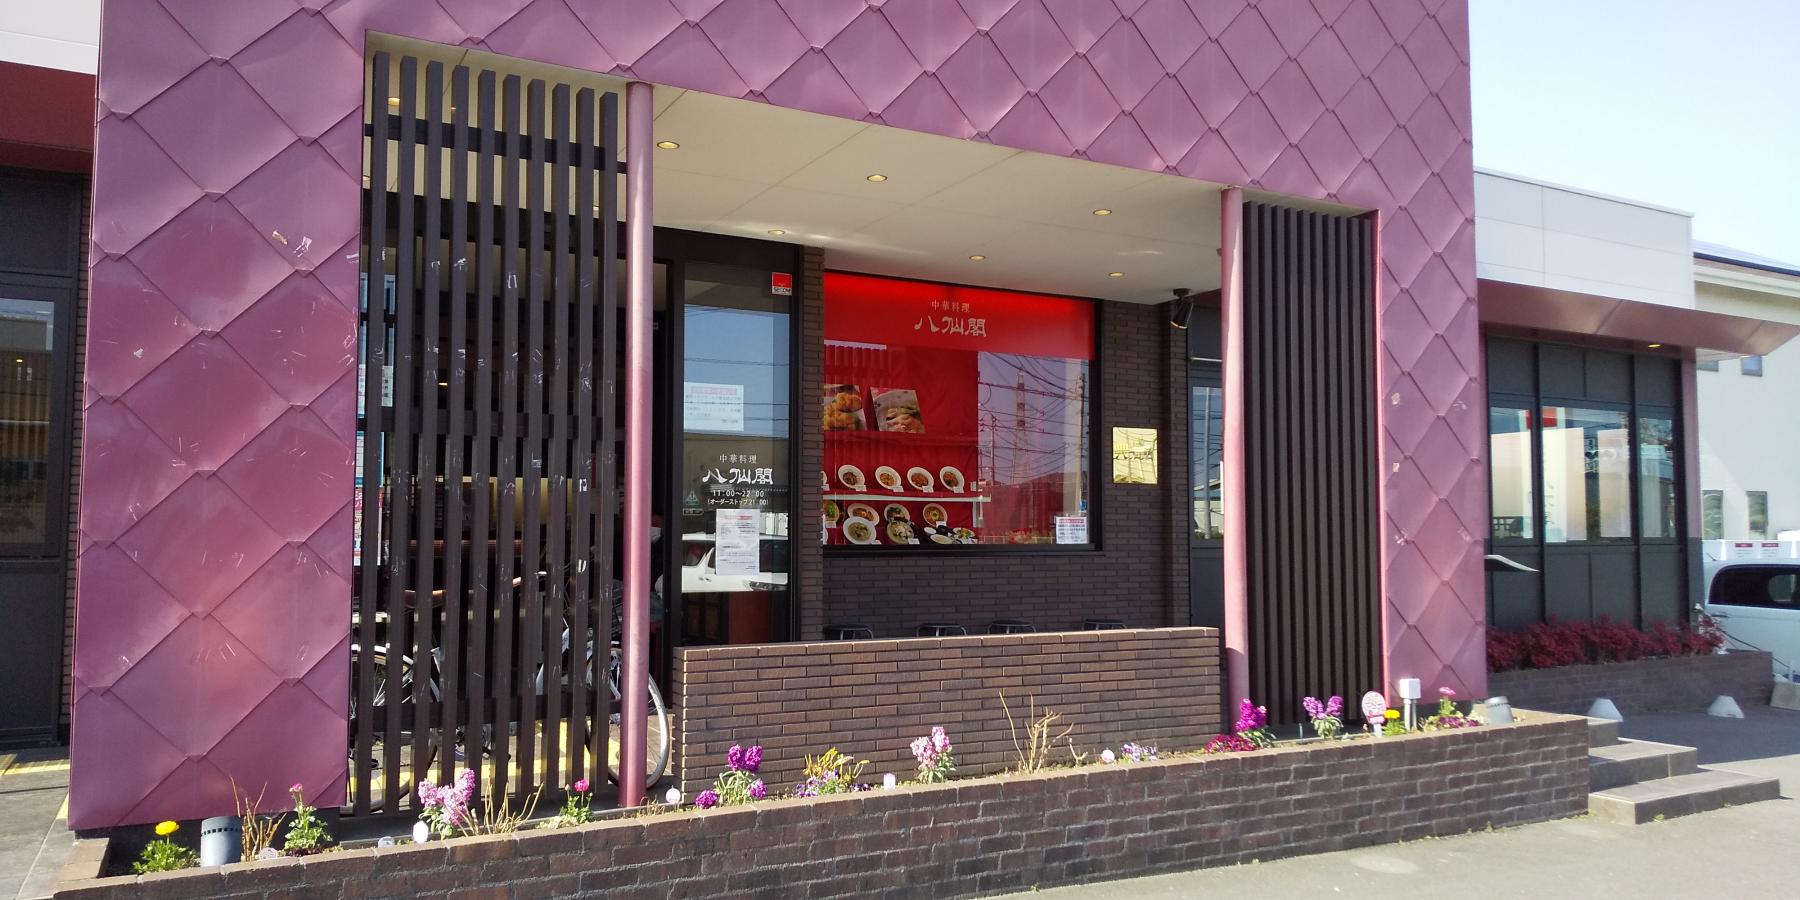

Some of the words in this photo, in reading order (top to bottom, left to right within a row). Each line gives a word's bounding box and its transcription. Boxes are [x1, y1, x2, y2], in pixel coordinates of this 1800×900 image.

[931, 299, 970, 313] 中華料理
[914, 315, 987, 338] 八仙閣
[719, 453, 757, 465] 中華料理
[702, 467, 774, 485] 八仙閣
